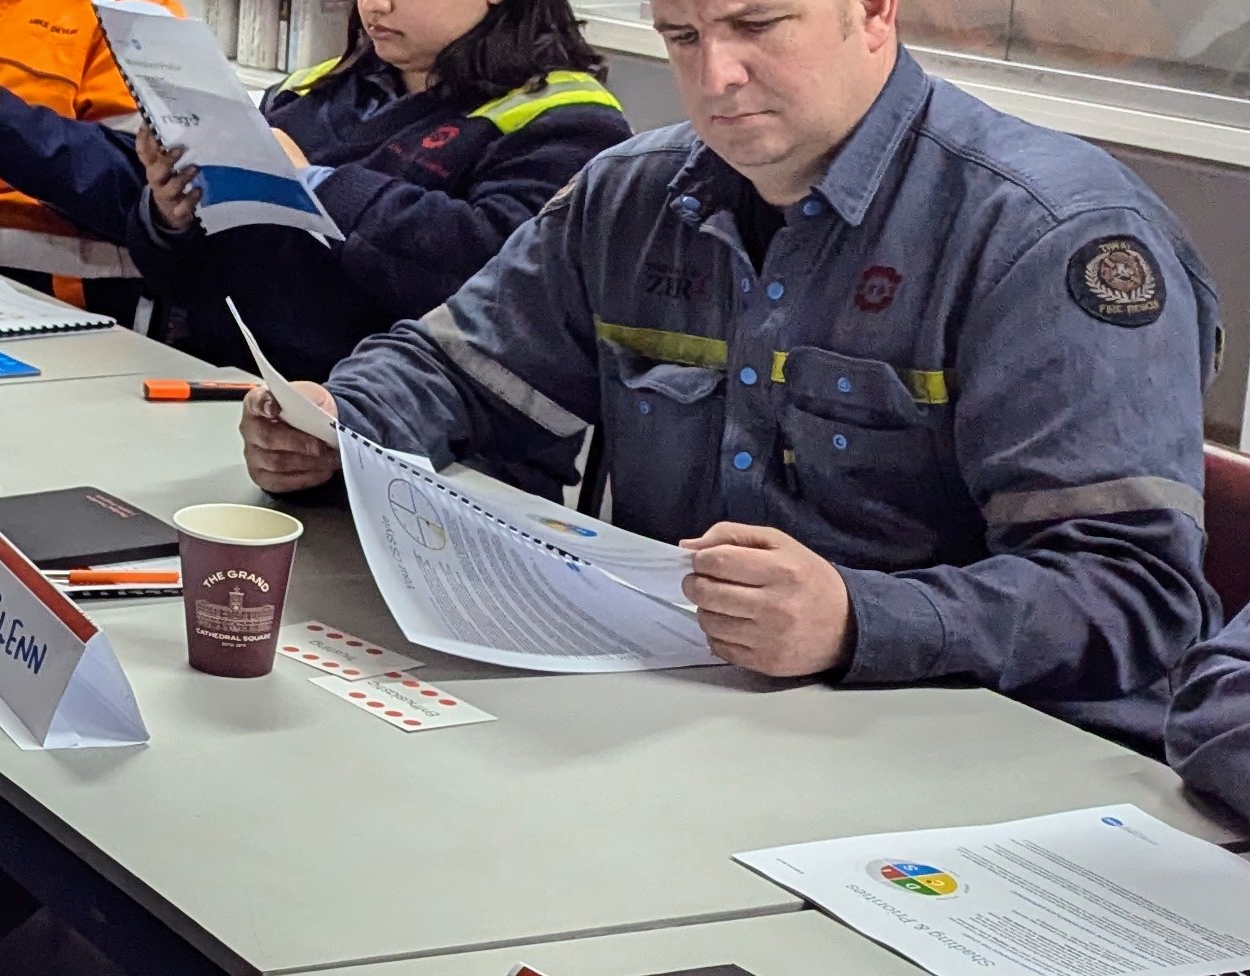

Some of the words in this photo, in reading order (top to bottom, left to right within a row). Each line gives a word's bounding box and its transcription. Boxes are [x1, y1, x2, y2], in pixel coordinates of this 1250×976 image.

[202, 571, 226, 588] THE
[227, 570, 270, 593] GRAND
[195, 627, 241, 642] CATHEDRAL
[242, 632, 272, 642] SQUARE
[845, 884, 917, 924] Priorities
[914, 923, 931, 934] &
[926, 931, 996, 969] Shading
